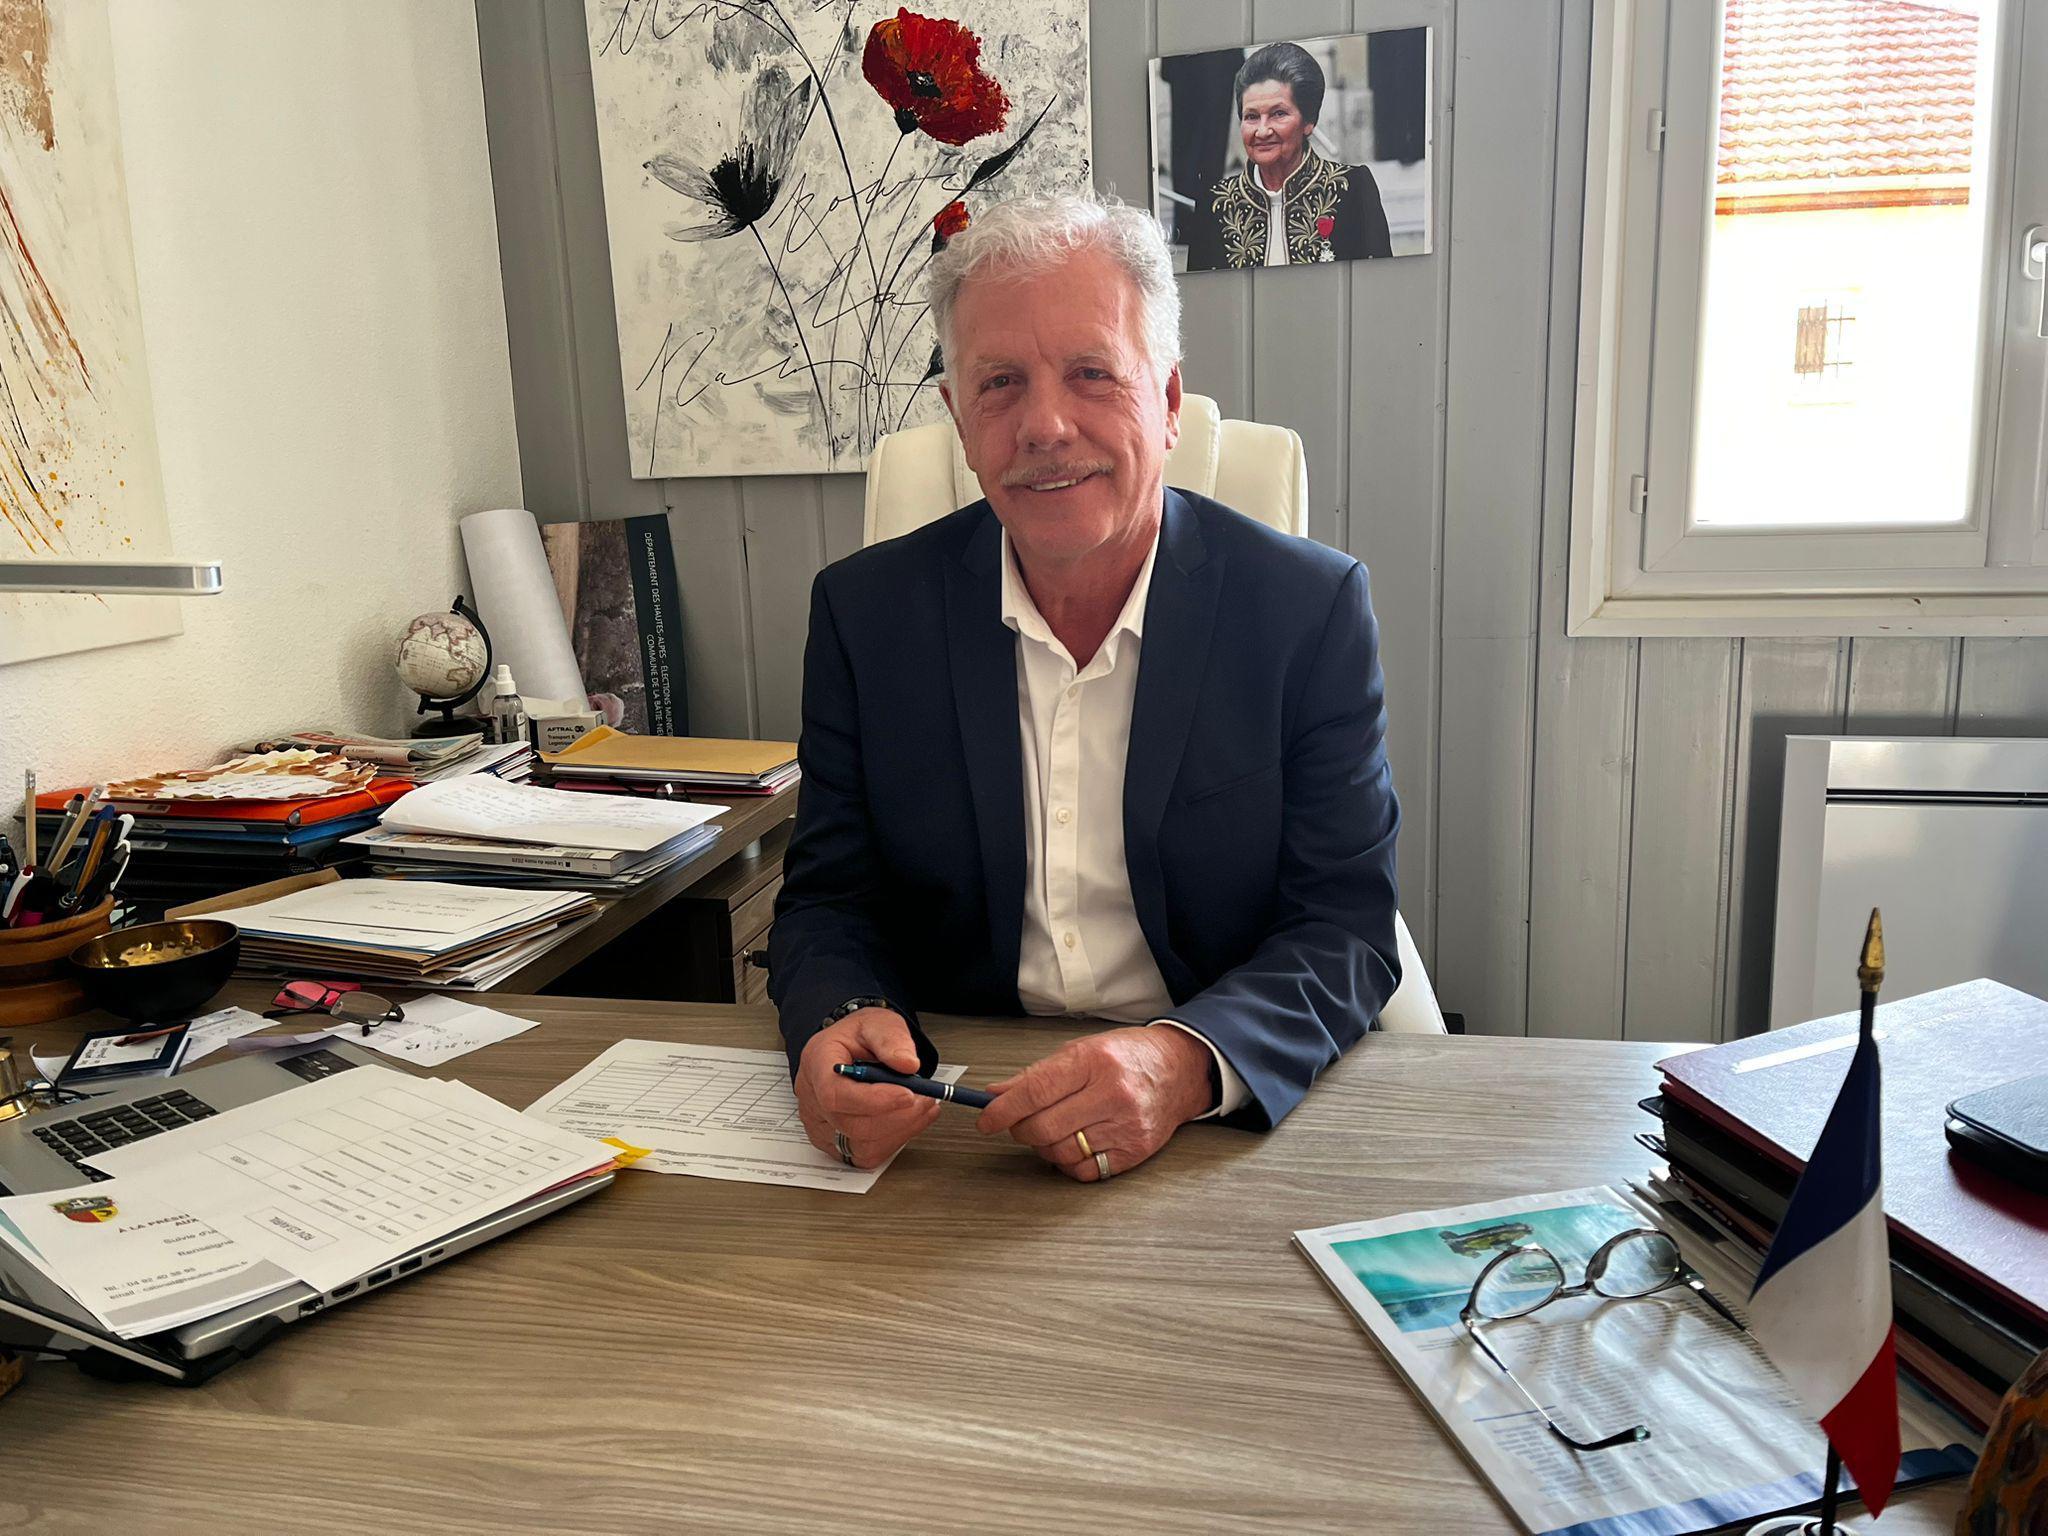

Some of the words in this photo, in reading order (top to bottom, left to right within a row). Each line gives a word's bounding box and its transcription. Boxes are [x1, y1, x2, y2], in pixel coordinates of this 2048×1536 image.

[651, 588, 661, 603] DES
[653, 604, 667, 659] HAUTES-ALPES
[646, 634, 659, 676] COMMUNE
[651, 677, 660, 688] DE
[660, 665, 672, 706] ÉLECTIONS
[652, 689, 661, 700] LA
[130, 1222, 147, 1232] LA
